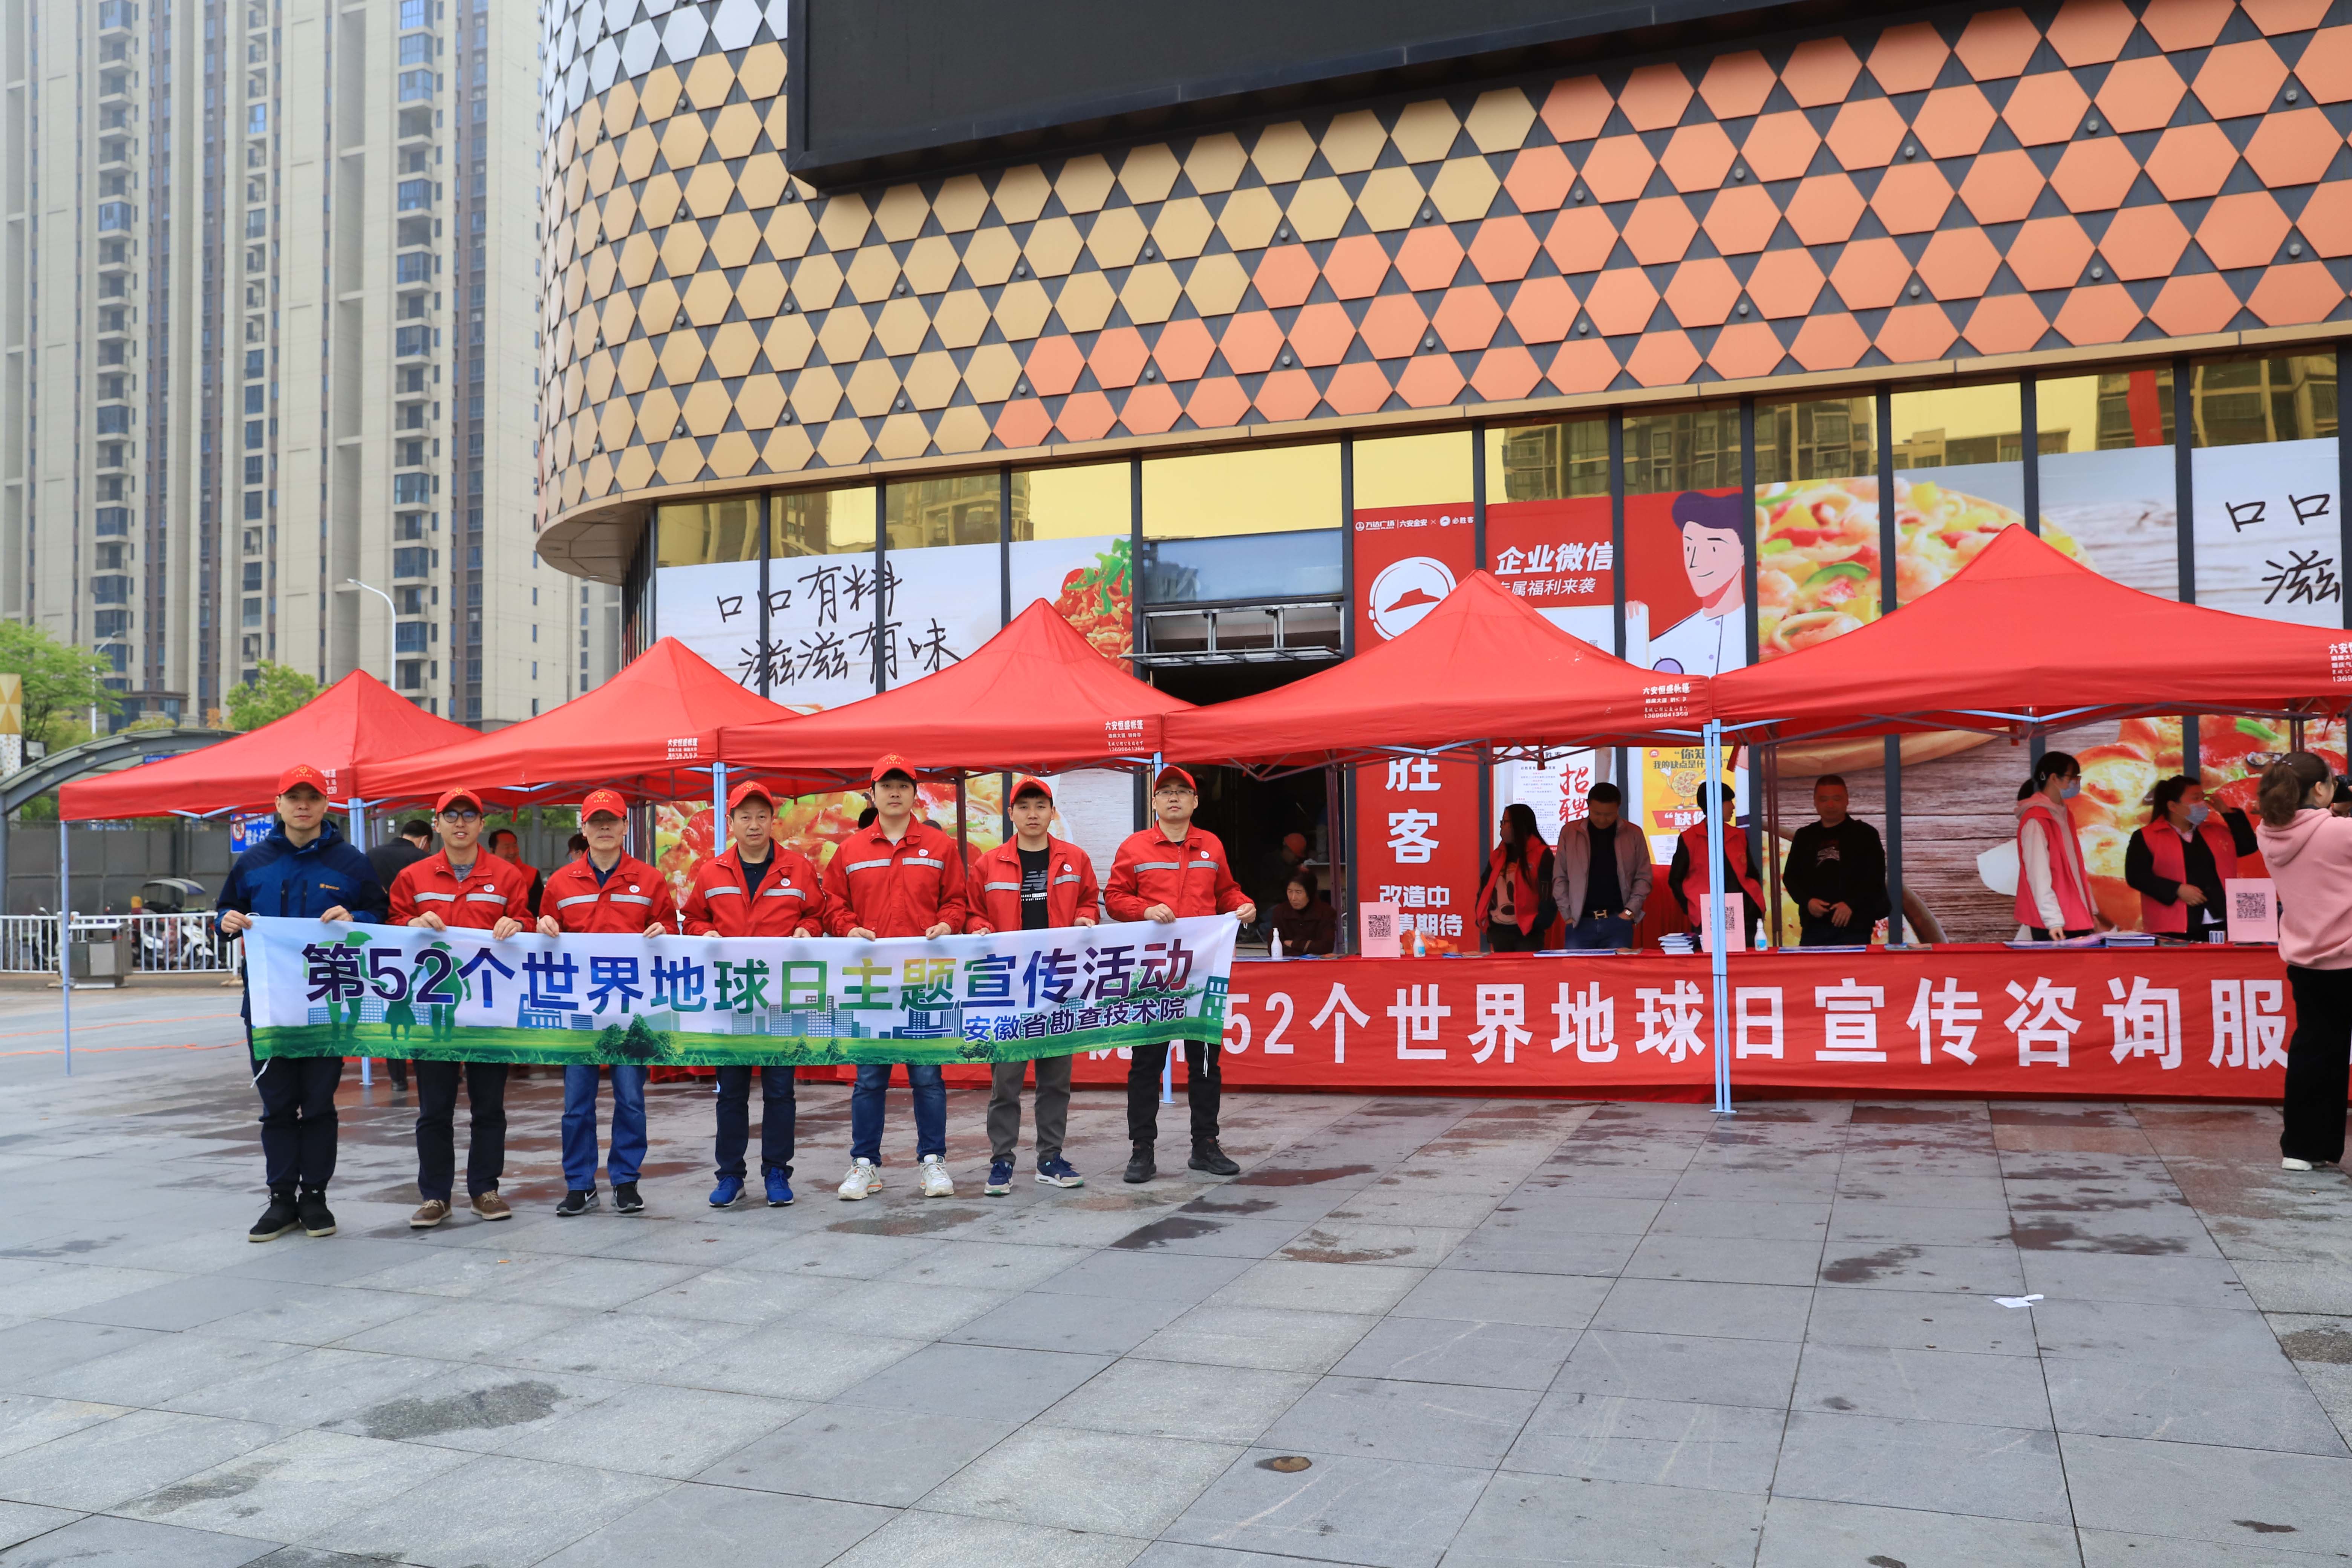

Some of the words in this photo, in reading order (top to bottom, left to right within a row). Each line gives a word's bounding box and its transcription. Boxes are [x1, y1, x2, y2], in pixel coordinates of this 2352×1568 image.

[1400, 519, 1427, 528] 六安金安
[2225, 493, 2330, 533] 口口
[1494, 541, 1614, 575] 企业微信
[2262, 550, 2340, 604] 滋
[717, 560, 903, 626] 口口有料
[738, 618, 962, 687] 滋滋有味
[1105, 720, 1143, 730] 六安恒盛帐篷
[1380, 885, 1449, 908] 改造中
[301, 938, 1194, 1015] 第52个世界地球日主题宣传活动
